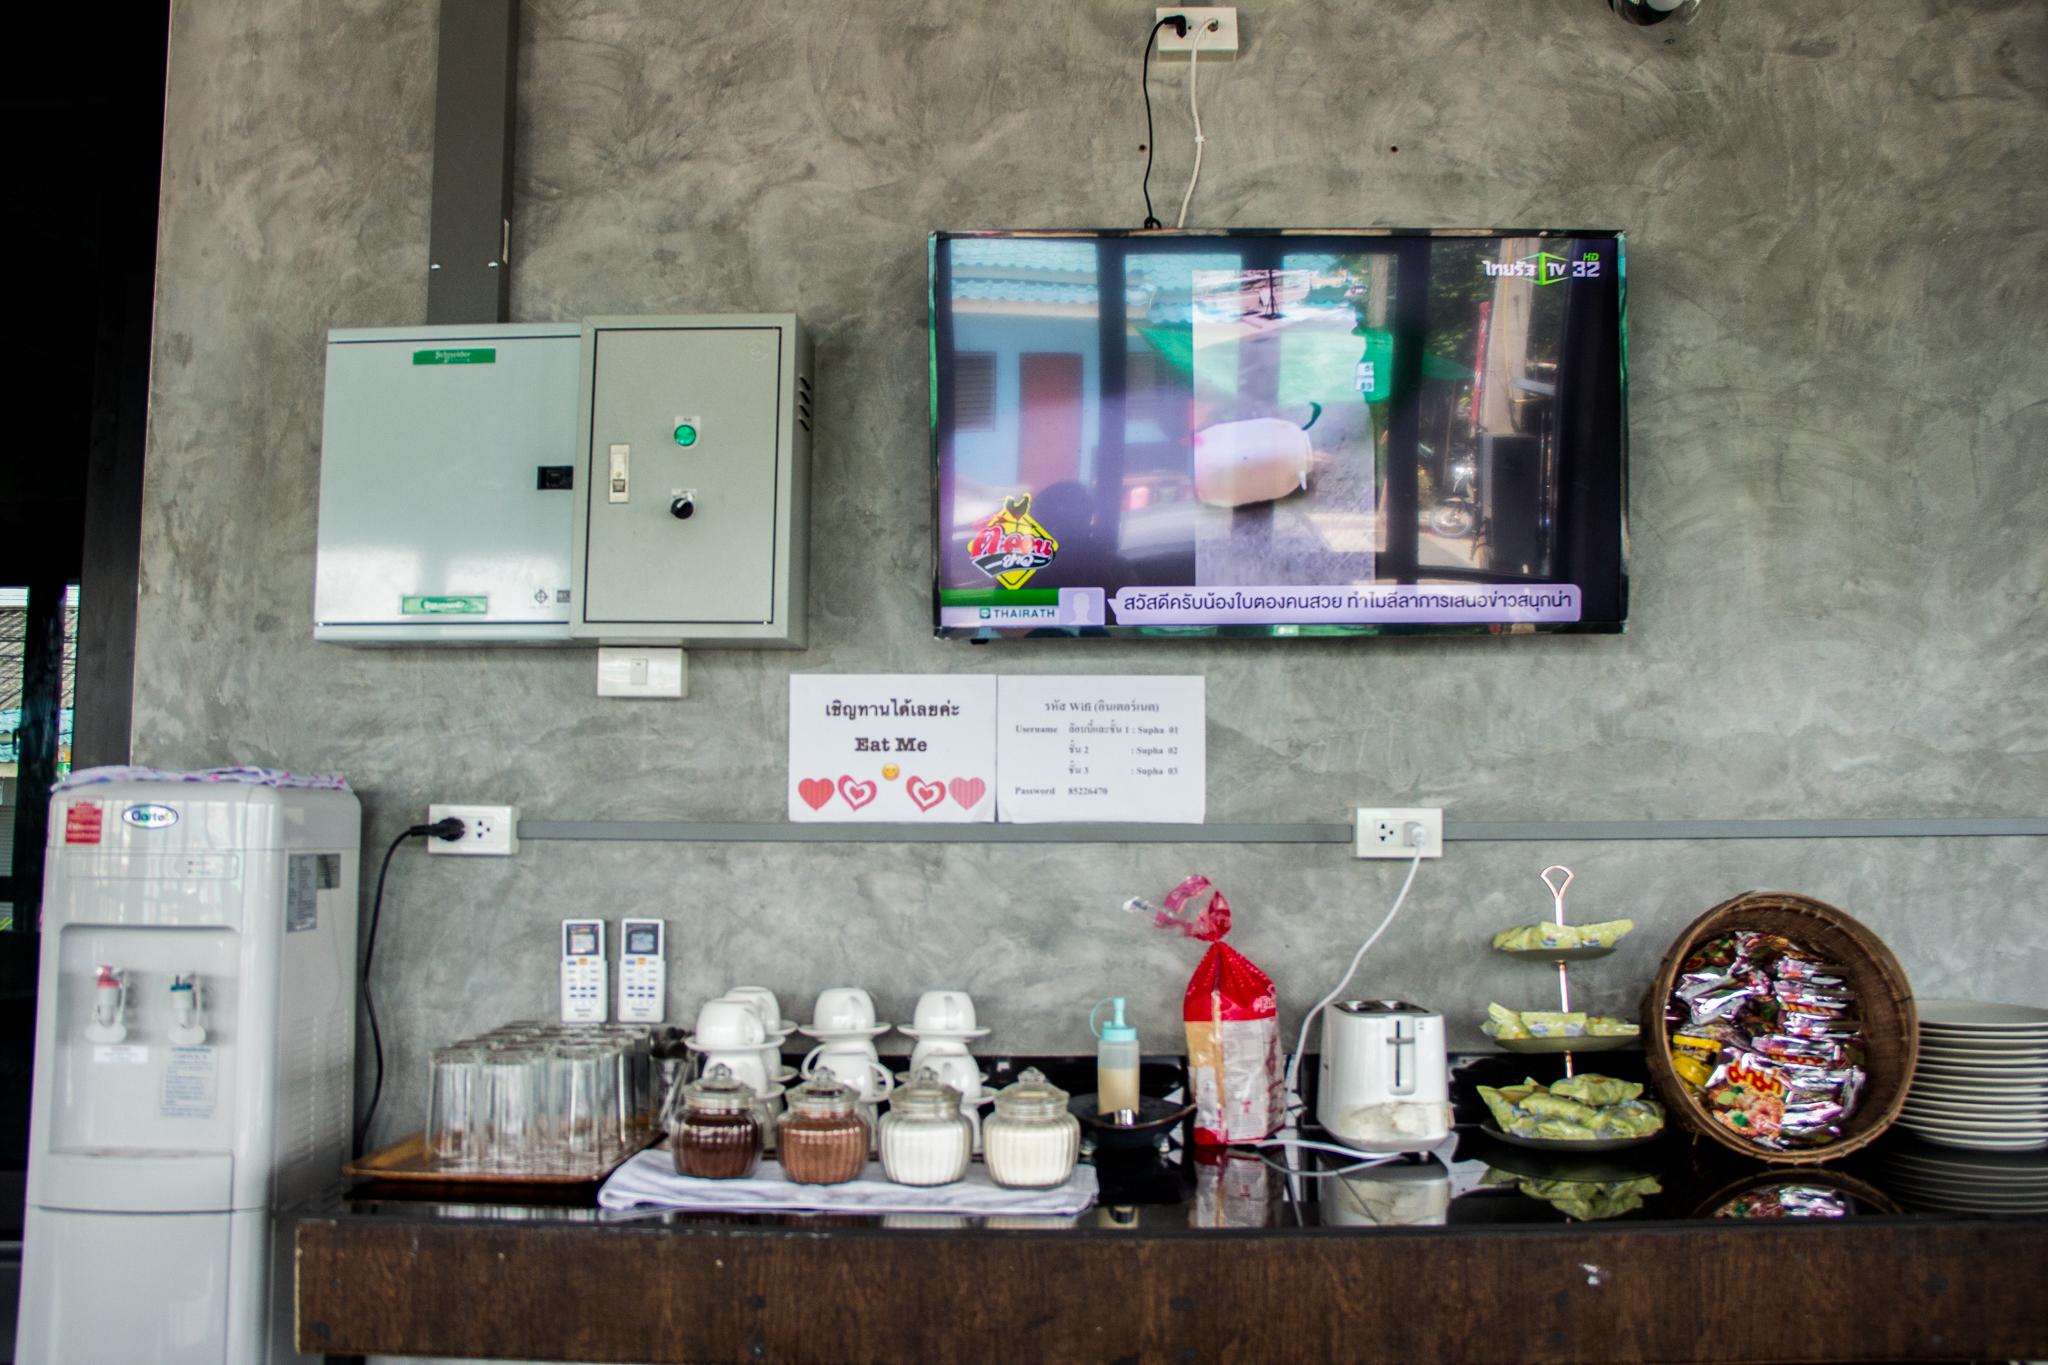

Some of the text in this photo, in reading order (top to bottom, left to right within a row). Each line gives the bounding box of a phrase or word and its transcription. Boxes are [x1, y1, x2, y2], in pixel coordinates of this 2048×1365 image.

[1583, 252, 1599, 261] HD
[1546, 262, 1567, 277] TV
[1572, 260, 1600, 278] 32
[1124, 591, 1572, 612] สวัสดีครับน้องใบตองคนสวย ทำไมลีลาการเสนอข่าวสนุกน่า
[993, 608, 1056, 619] THAIRATH
[825, 697, 960, 721] เชิญทานได้เลยค่ะ
[1044, 698, 1067, 712] รหัส
[1069, 701, 1092, 712] Wifi
[1015, 724, 1059, 734] Username
[1137, 725, 1165, 737] Supha
[1168, 725, 1179, 735] 01
[854, 736, 928, 753] Eat Me
[1135, 746, 1164, 757] Supha
[1167, 746, 1179, 756] 02
[1135, 766, 1164, 777] Supha
[1167, 766, 1179, 776] 03
[1014, 786, 1056, 796] Password
